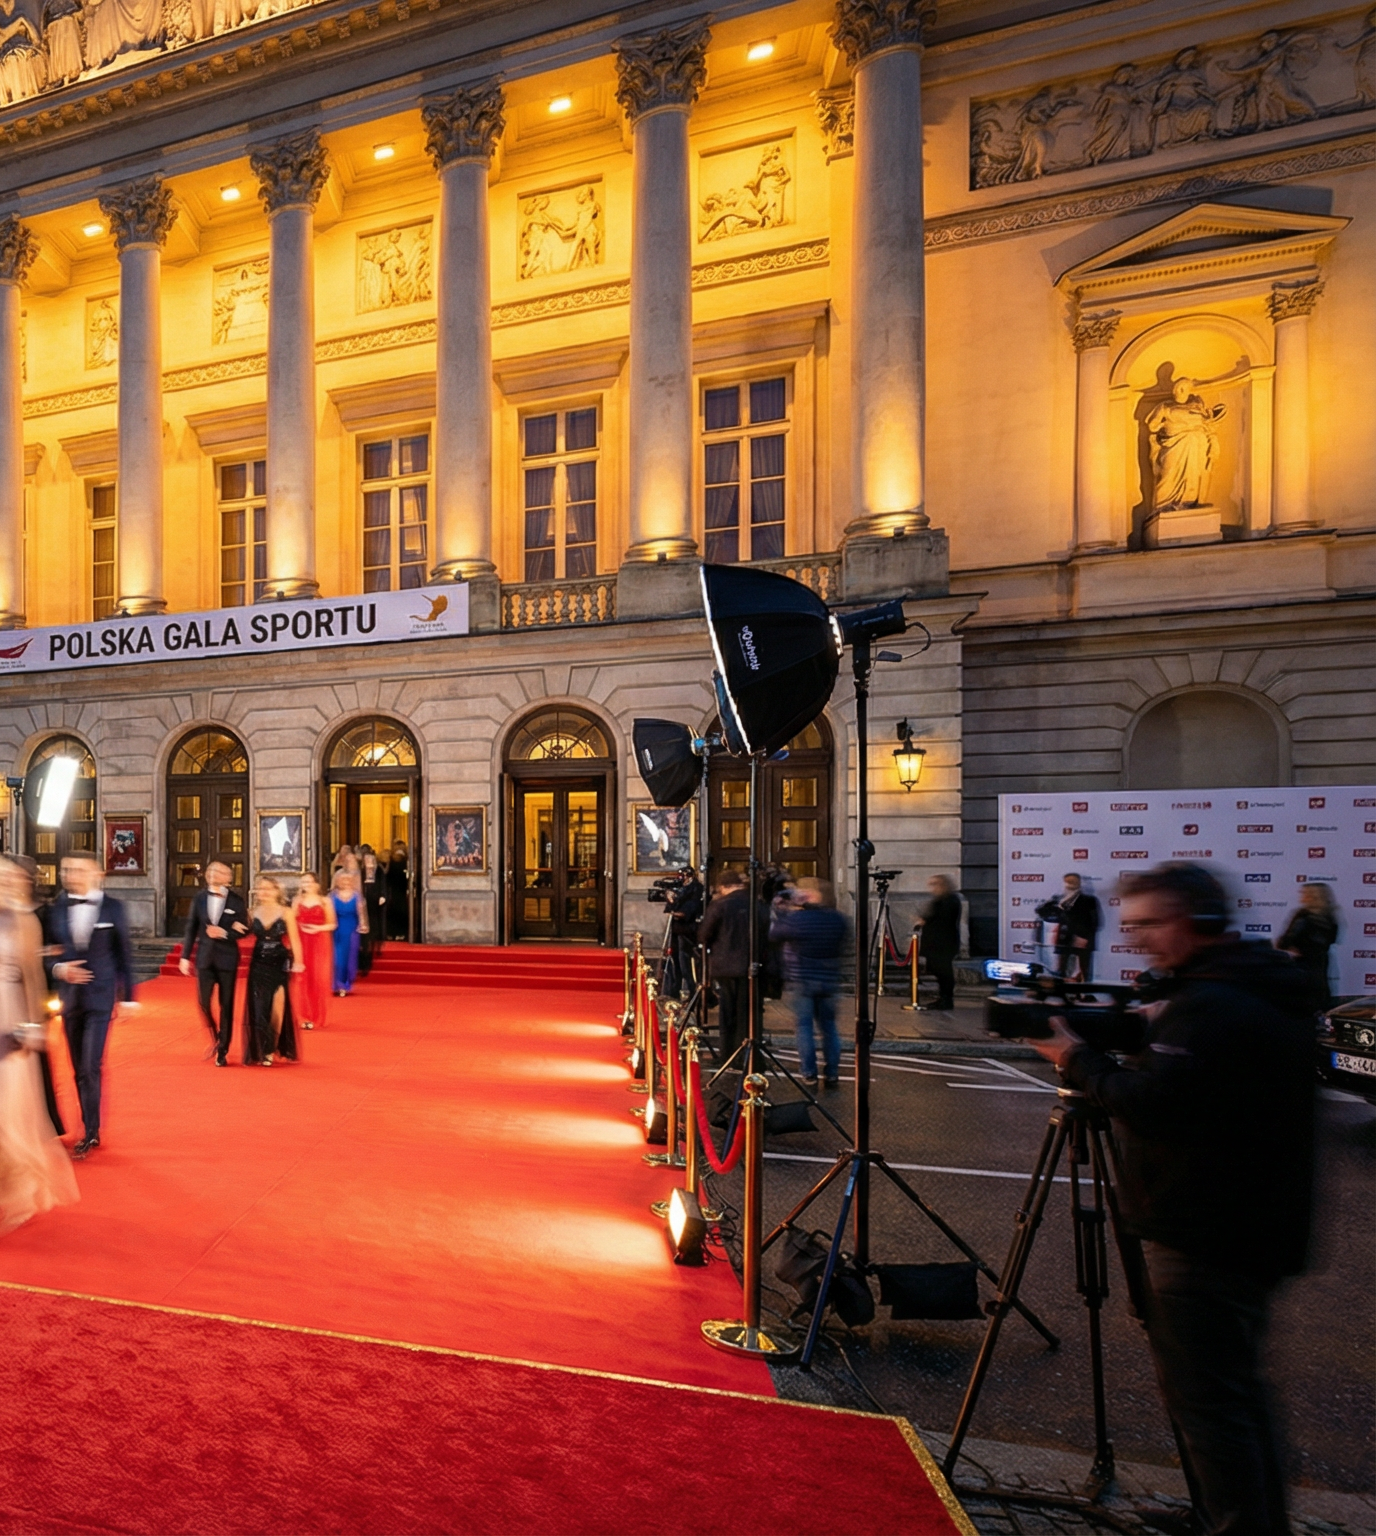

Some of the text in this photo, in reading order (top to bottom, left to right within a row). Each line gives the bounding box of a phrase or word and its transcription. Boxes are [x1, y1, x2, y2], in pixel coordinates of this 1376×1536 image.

[49, 603, 376, 661] POLSKA GALA SPORTU
